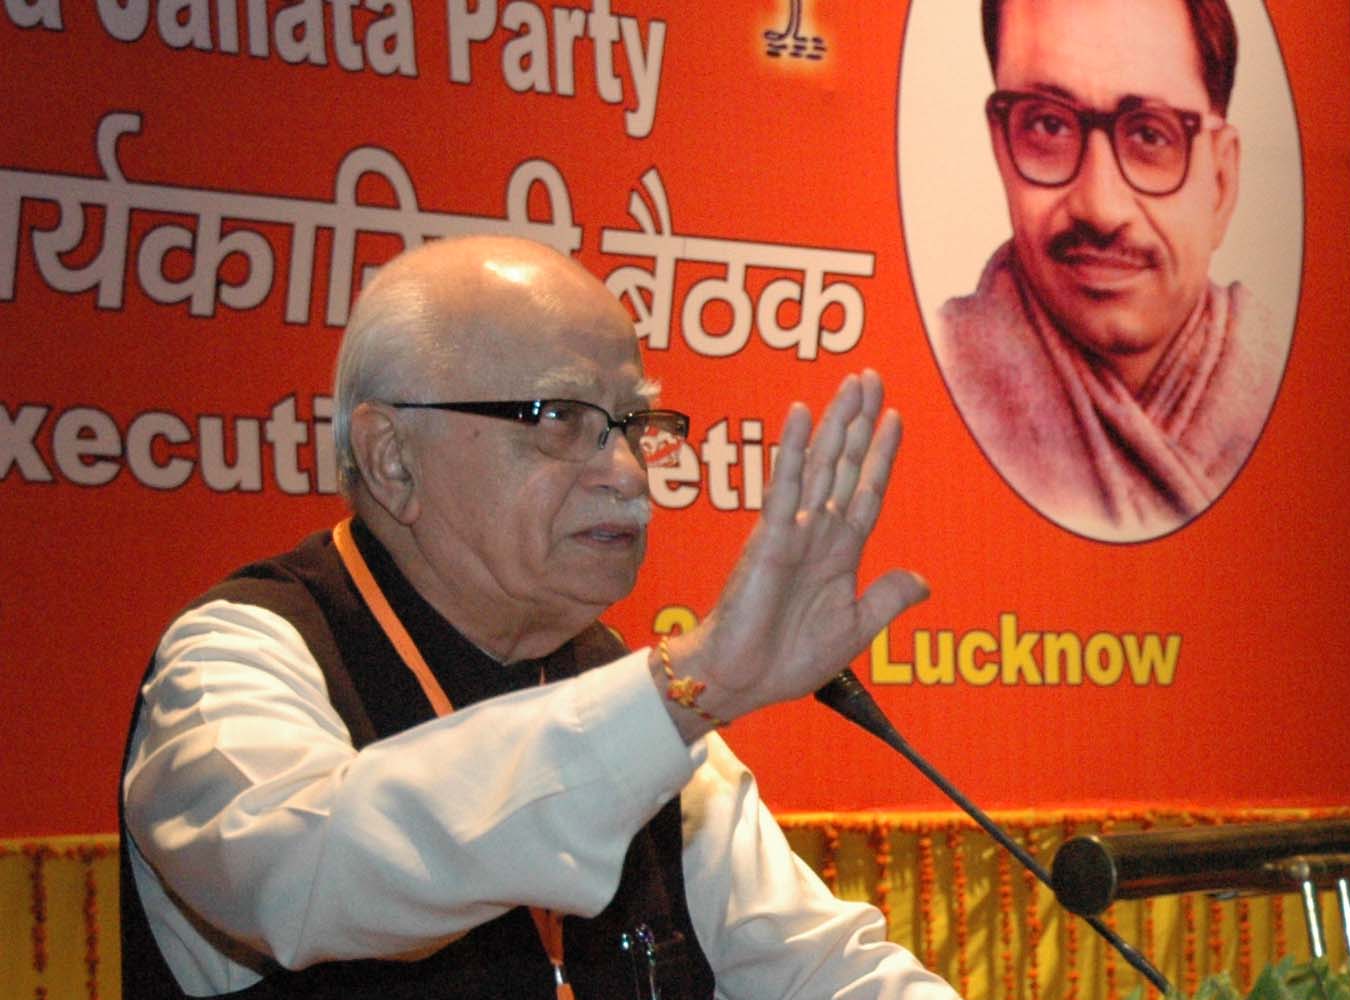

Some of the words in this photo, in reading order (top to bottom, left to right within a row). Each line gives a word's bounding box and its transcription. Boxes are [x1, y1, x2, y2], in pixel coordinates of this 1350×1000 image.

[447, 0, 668, 139] Party
[602, 167, 875, 361] बैठक
[870, 612, 1183, 686] Lucknow
